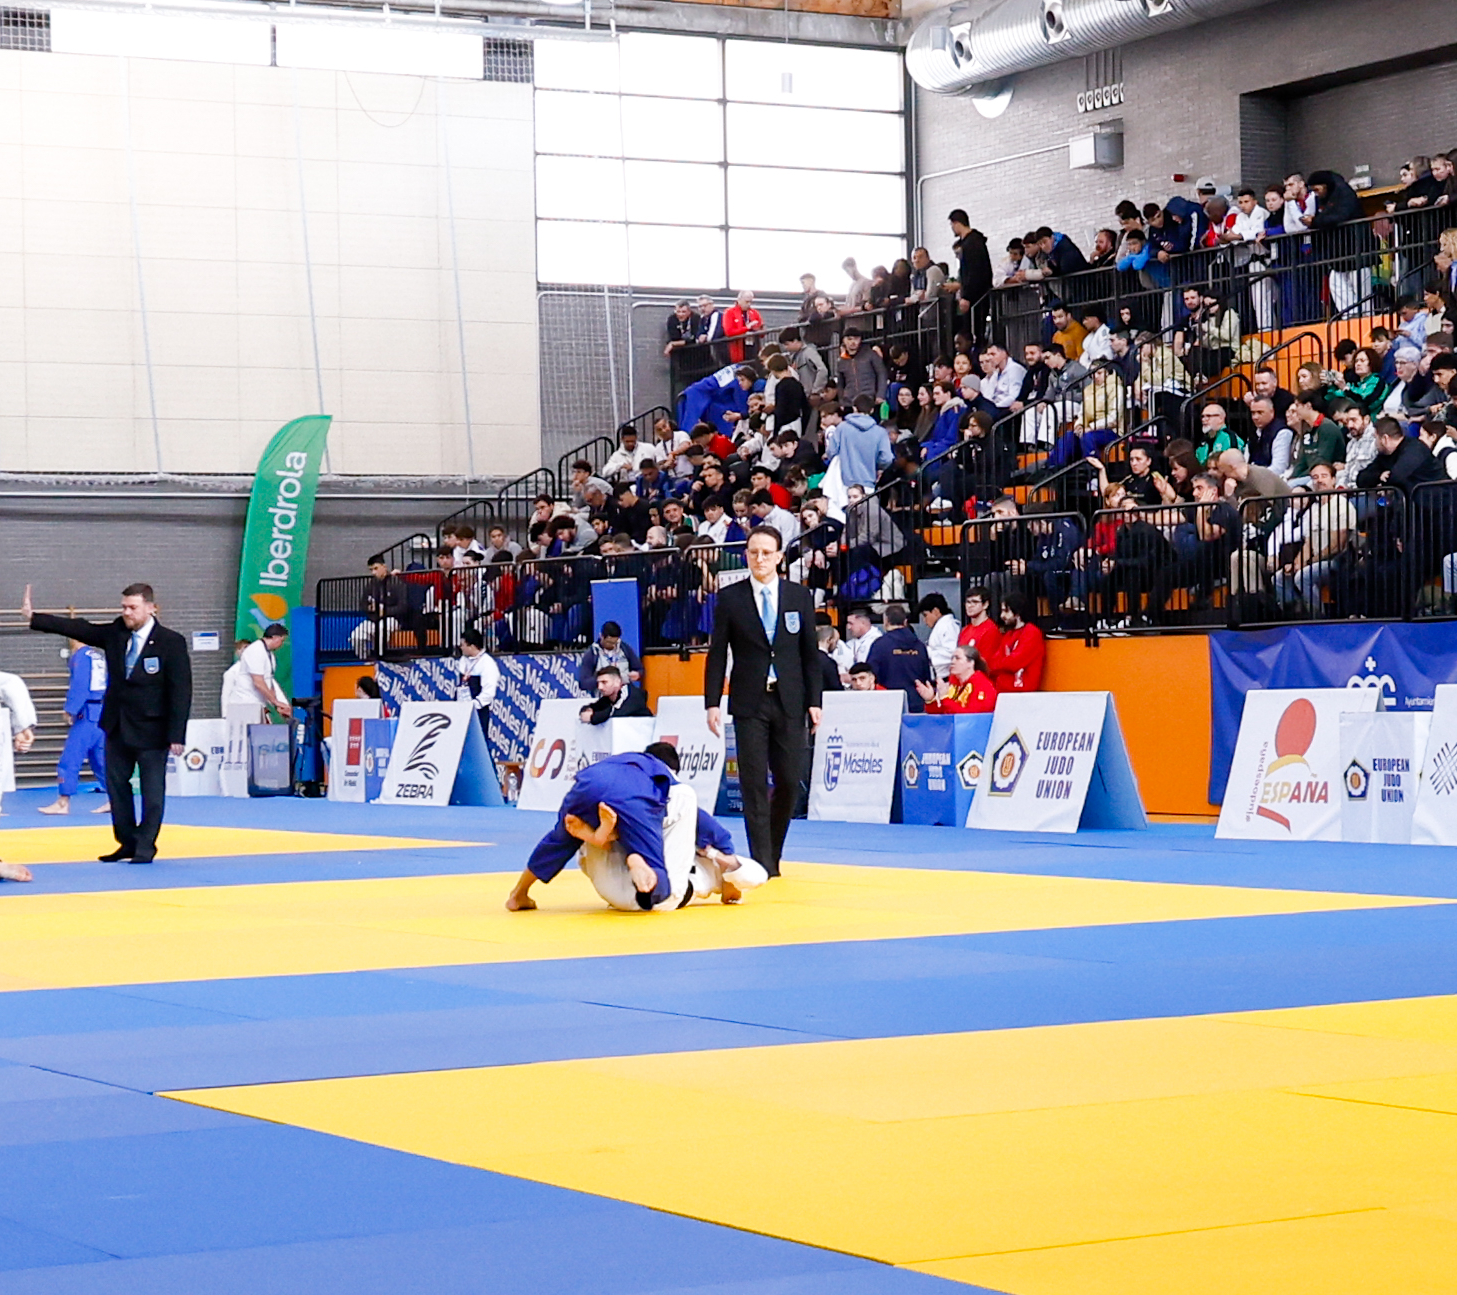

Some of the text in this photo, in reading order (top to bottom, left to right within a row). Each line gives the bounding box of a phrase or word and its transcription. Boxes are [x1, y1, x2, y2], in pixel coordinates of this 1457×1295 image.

[258, 451, 308, 587] Iberdrola
[1036, 731, 1095, 753] EUROPEAN
[679, 743, 719, 780] triglav
[843, 751, 883, 775] Móstoles
[921, 752, 952, 766] EUROPEAN
[1043, 755, 1075, 776] JUDO
[1372, 758, 1410, 773] EUROPEAN
[395, 783, 435, 799] ZEBRA
[1035, 779, 1074, 800] UNION
[1259, 773, 1329, 804] ESPAÑA
[1383, 773, 1402, 788] JUDO
[1380, 789, 1405, 803] UNION
